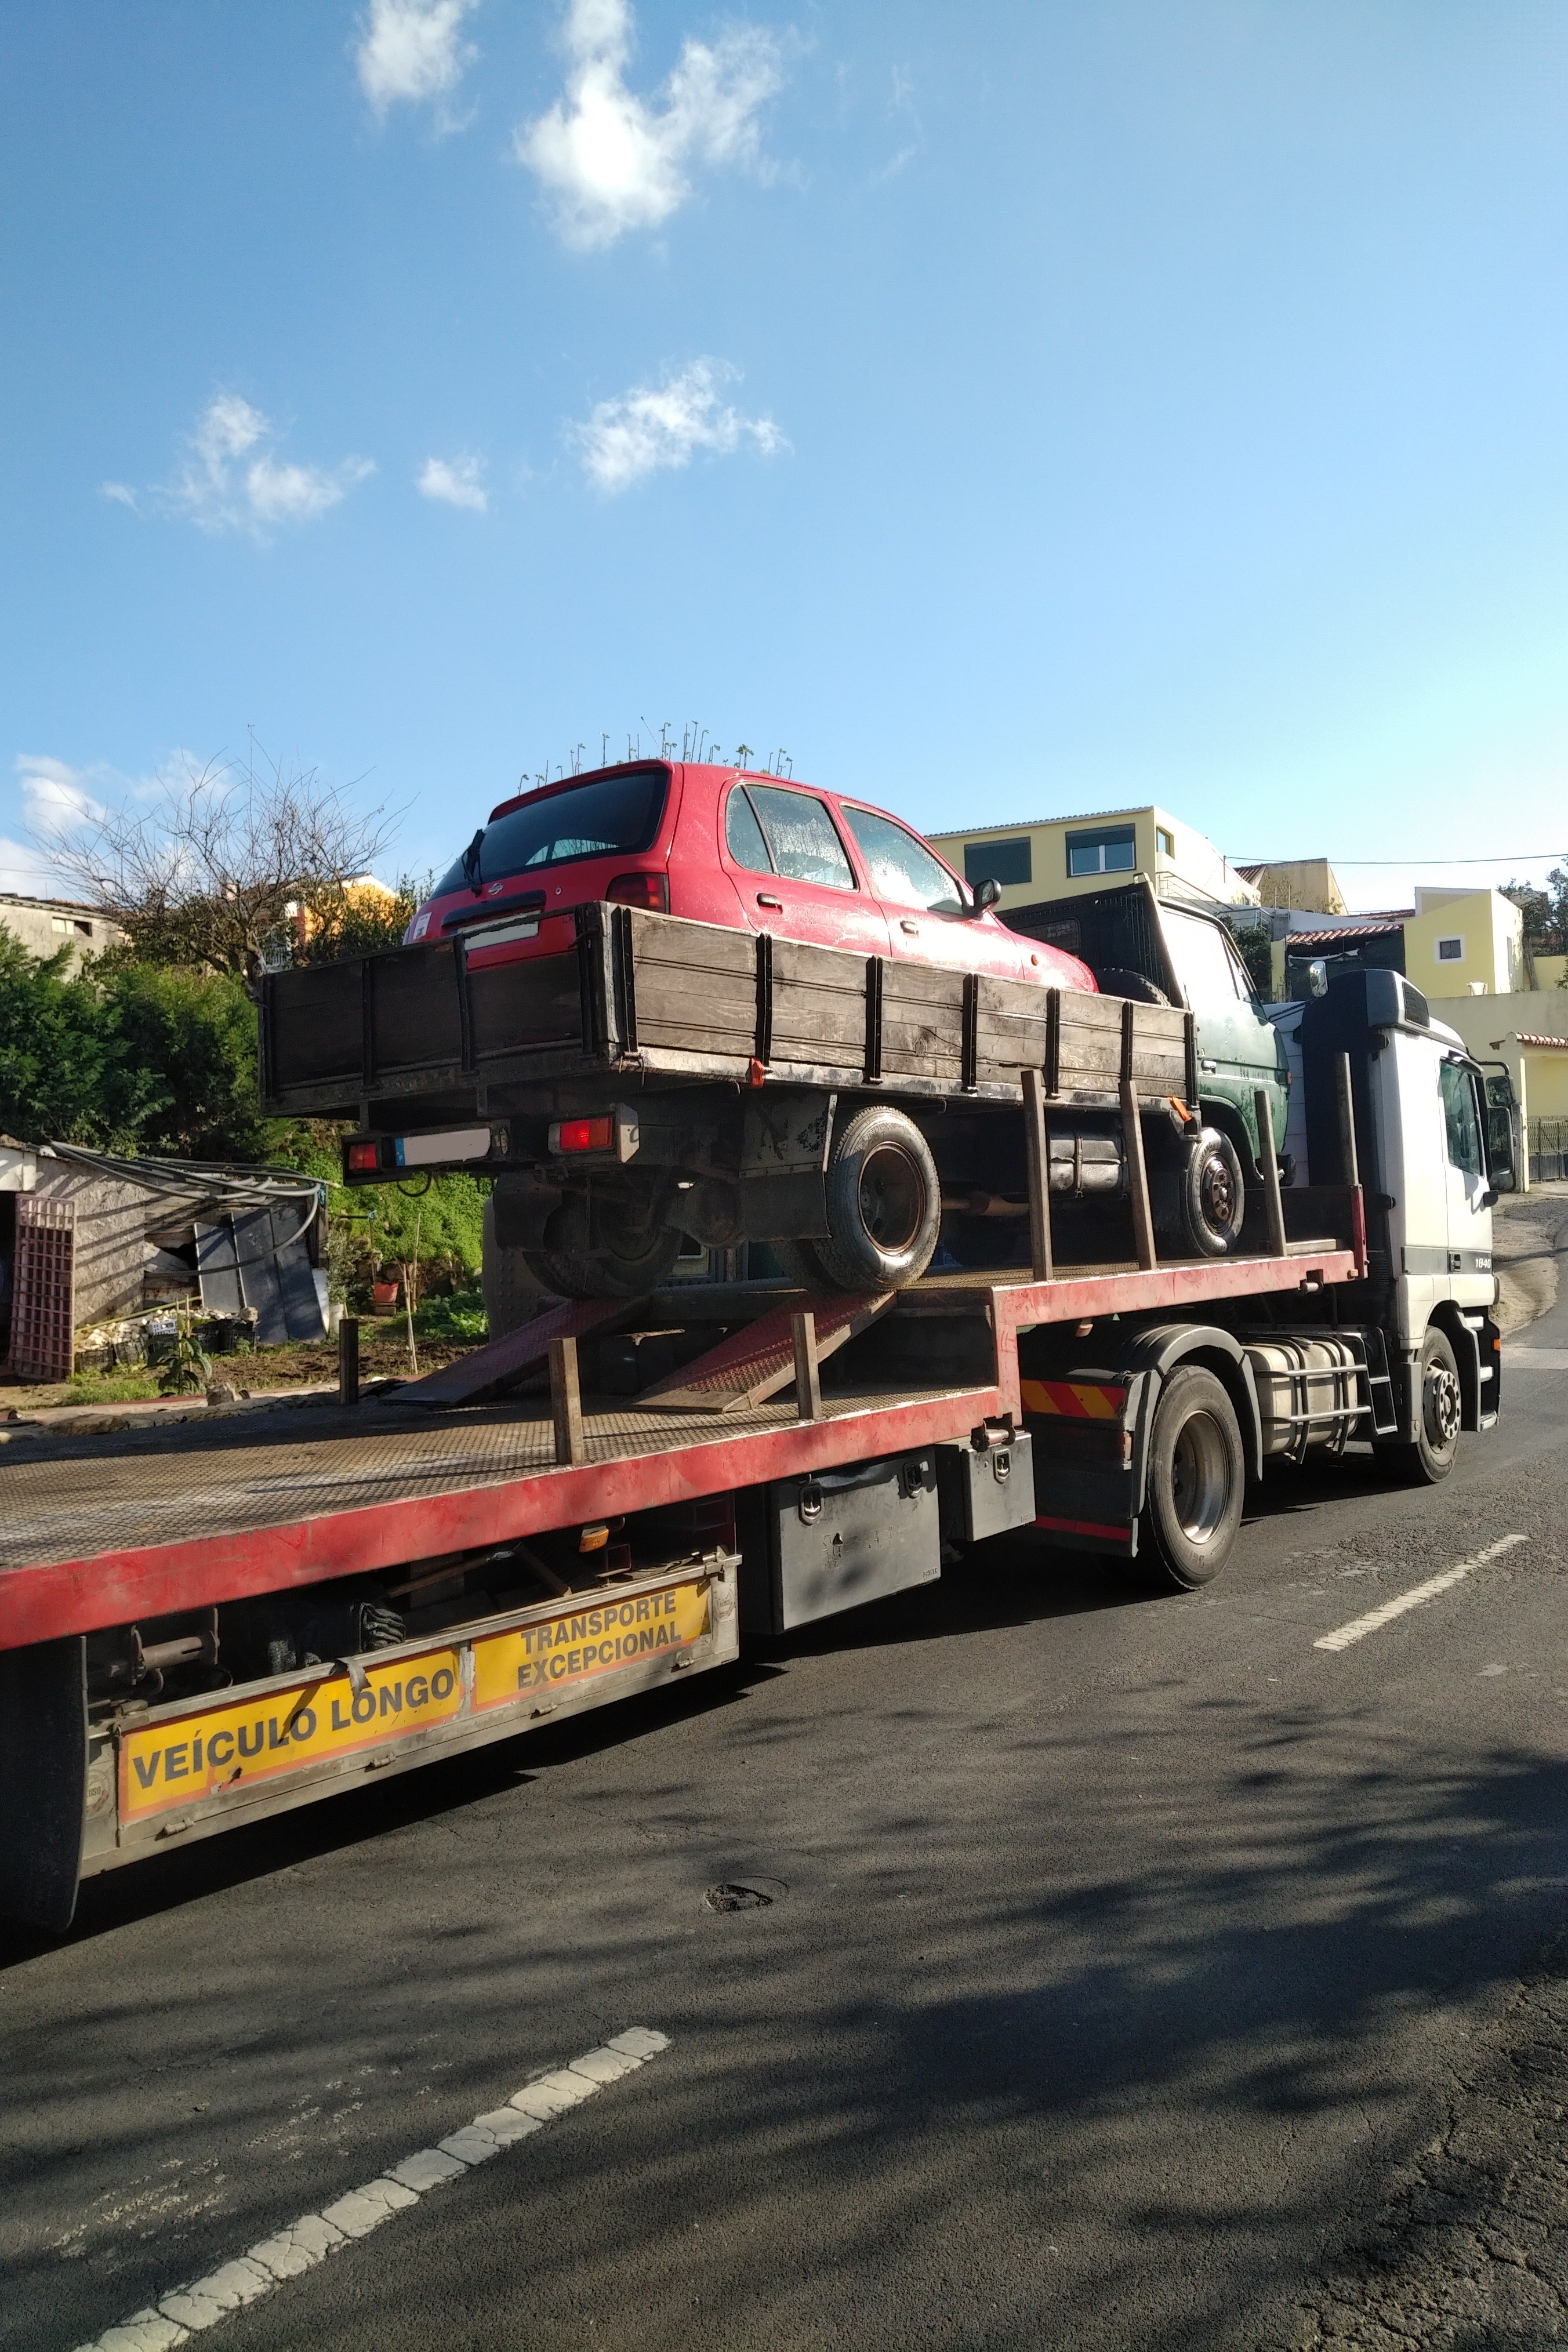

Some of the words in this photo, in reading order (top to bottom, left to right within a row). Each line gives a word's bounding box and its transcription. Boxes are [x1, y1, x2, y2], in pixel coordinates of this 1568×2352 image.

[1475, 1258, 1491, 1269] 1840
[517, 1621, 681, 1690] EXCEPCIONAL
[521, 1591, 677, 1655] TRANSPORTE
[132, 1708, 317, 1789] VEÍCULO
[331, 1668, 454, 1732] LONGO
